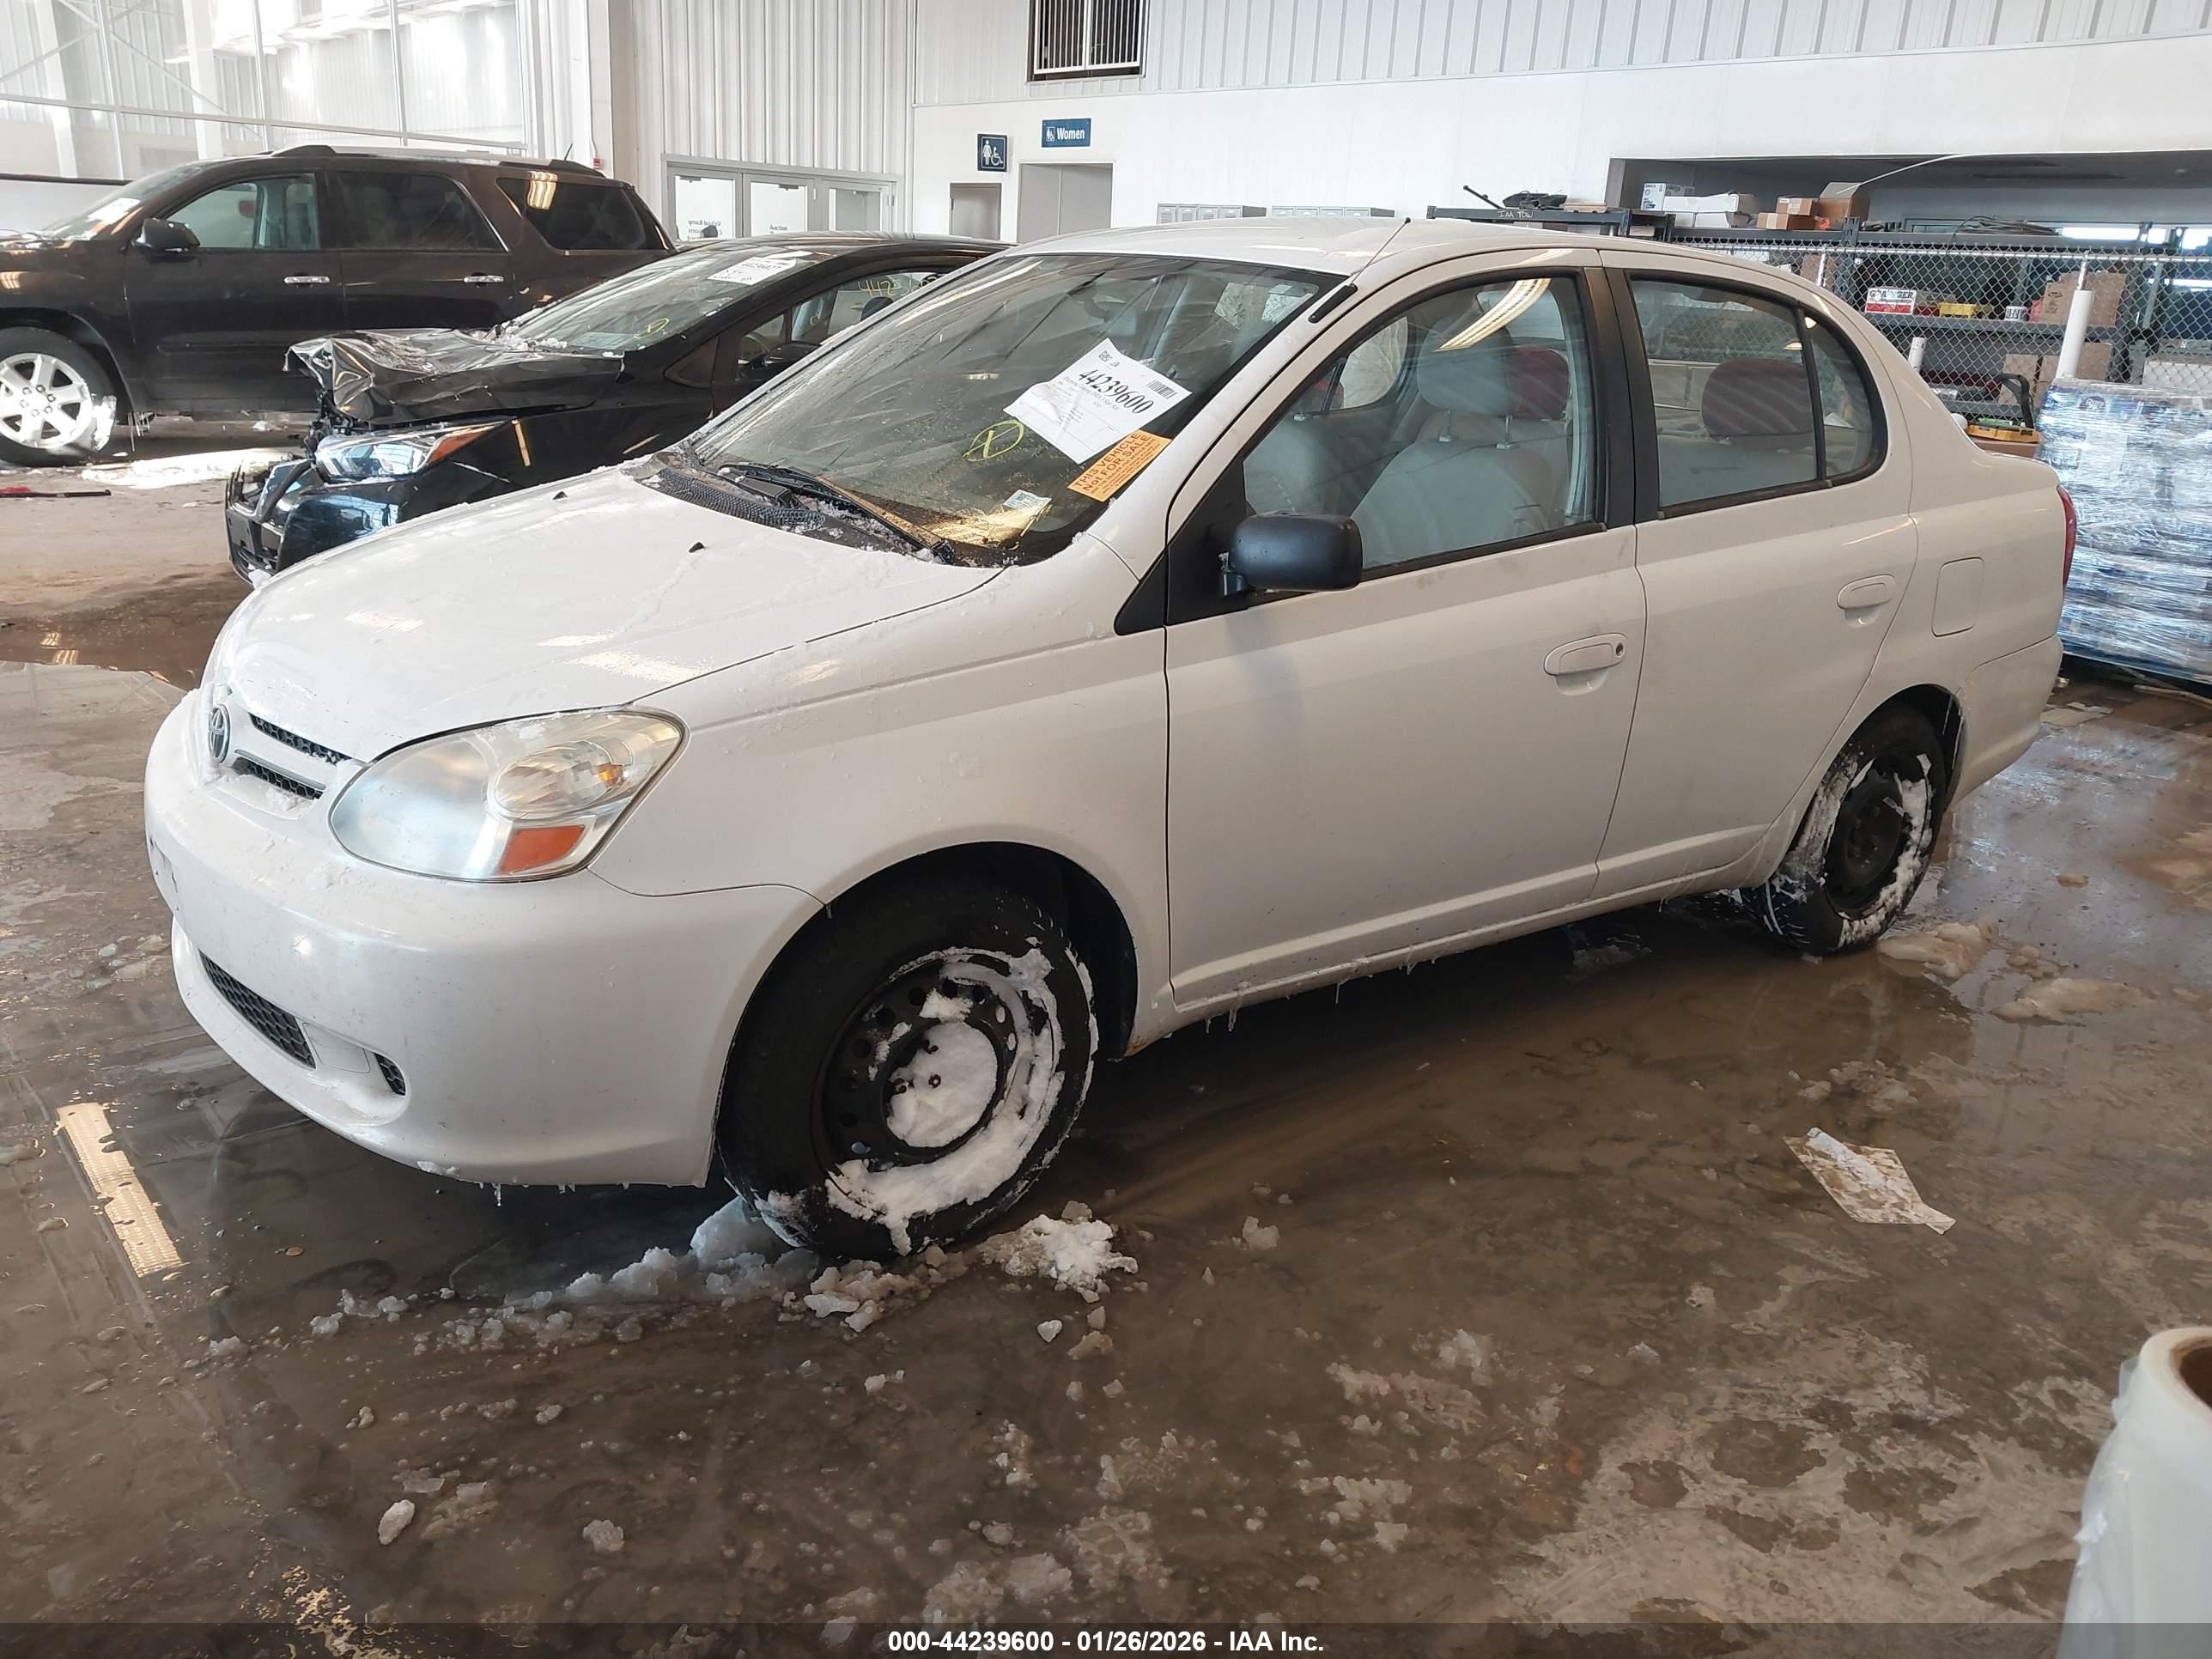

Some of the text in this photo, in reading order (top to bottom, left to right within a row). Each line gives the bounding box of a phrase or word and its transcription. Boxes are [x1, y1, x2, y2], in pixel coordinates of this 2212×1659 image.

[1056, 127, 1085, 140] Women
[1079, 369, 1154, 414] 44239600
[1074, 468, 1099, 488] THIS
[1096, 433, 1141, 468] VEHICLE
[1082, 477, 1101, 491] Not
[1100, 457, 1124, 477] FOR
[1121, 434, 1151, 458] SALE
